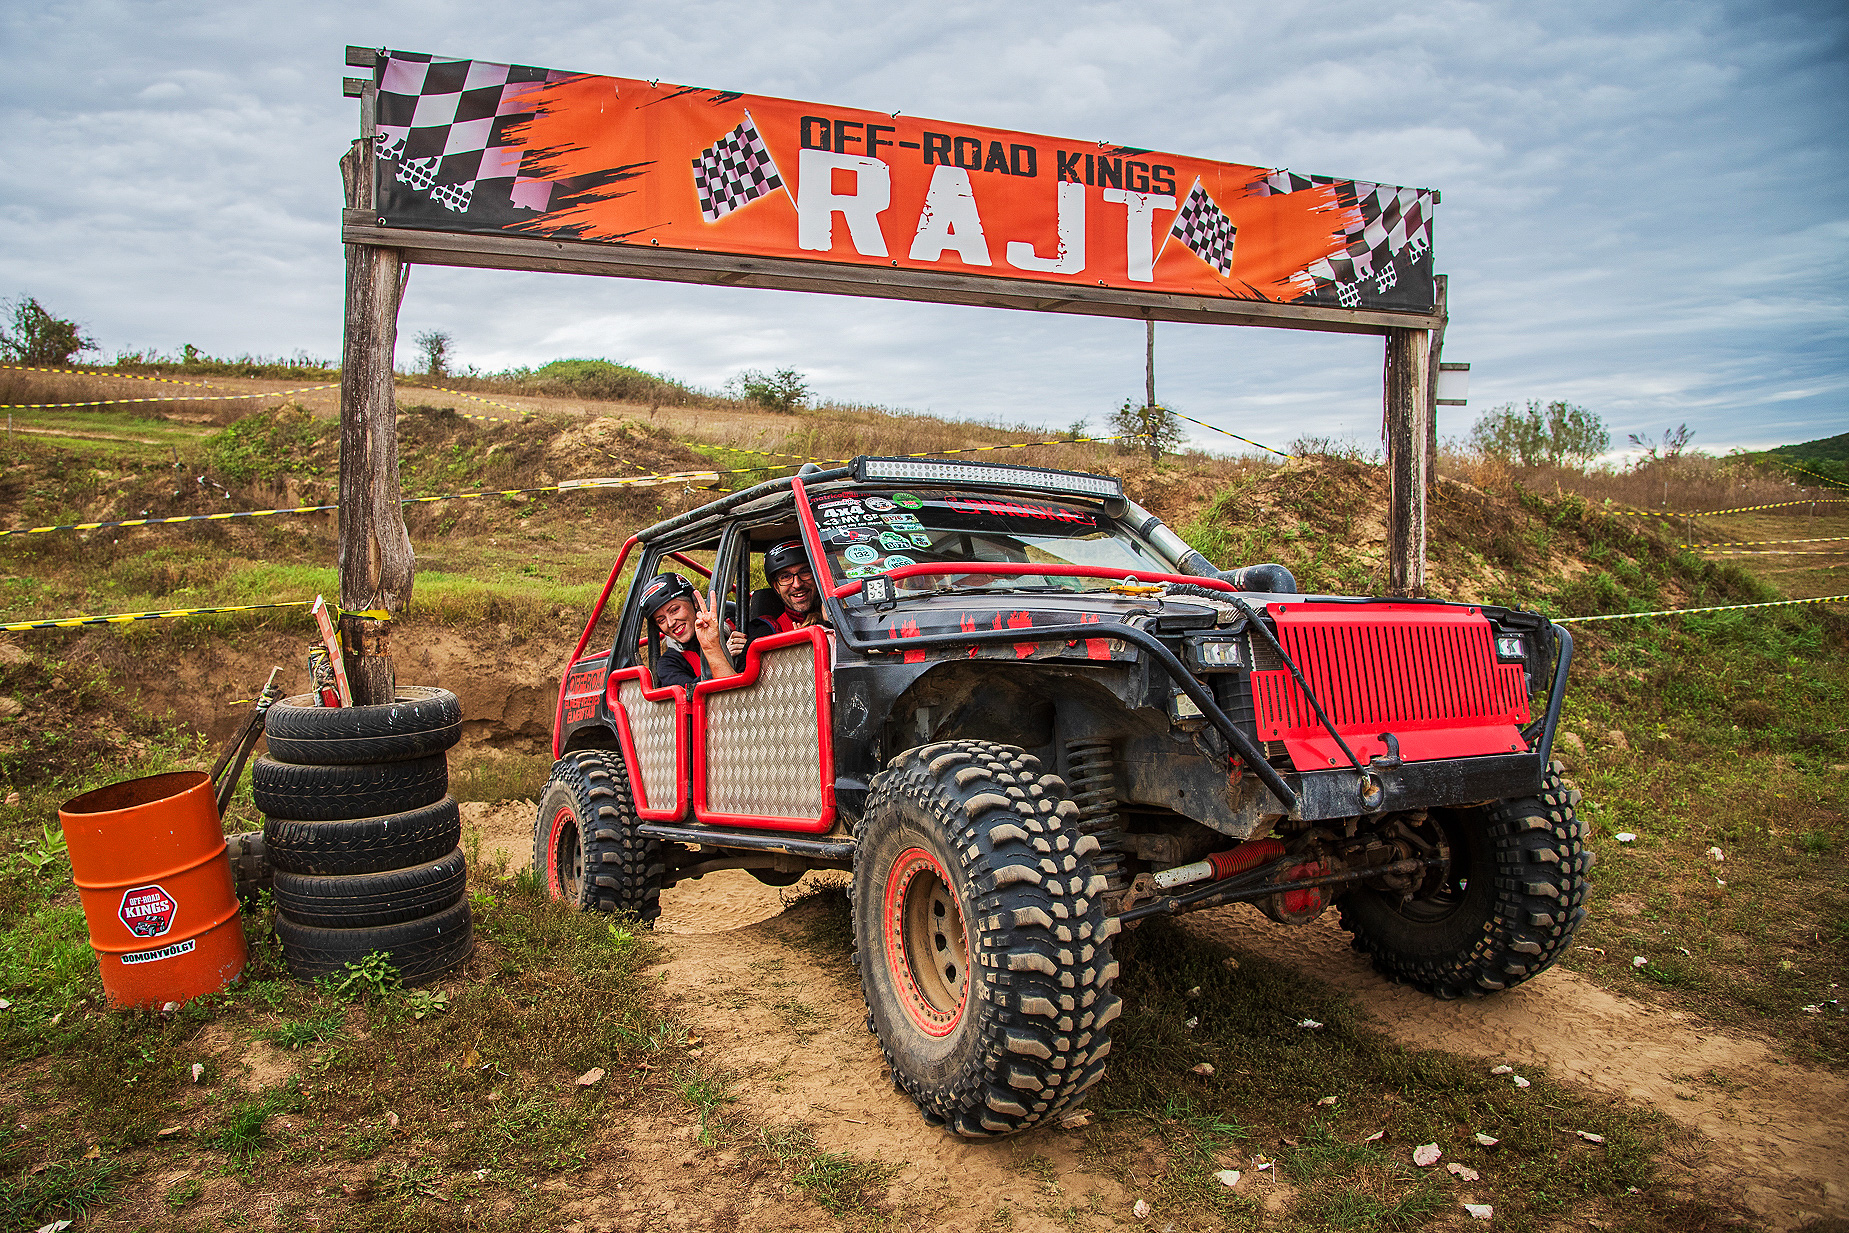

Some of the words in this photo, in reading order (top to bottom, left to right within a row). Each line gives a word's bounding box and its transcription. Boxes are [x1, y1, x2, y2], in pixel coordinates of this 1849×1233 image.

[800, 116, 1038, 178] OFF-ROAD
[1056, 149, 1177, 196] KINGS
[798, 148, 1177, 283] RAJT
[841, 515, 860, 524] MY
[963, 499, 1076, 523] PIROSKA
[124, 900, 170, 919] KINGS
[129, 892, 161, 907] OFF-ROAD
[122, 940, 196, 964] DOMONYVÖLGY
